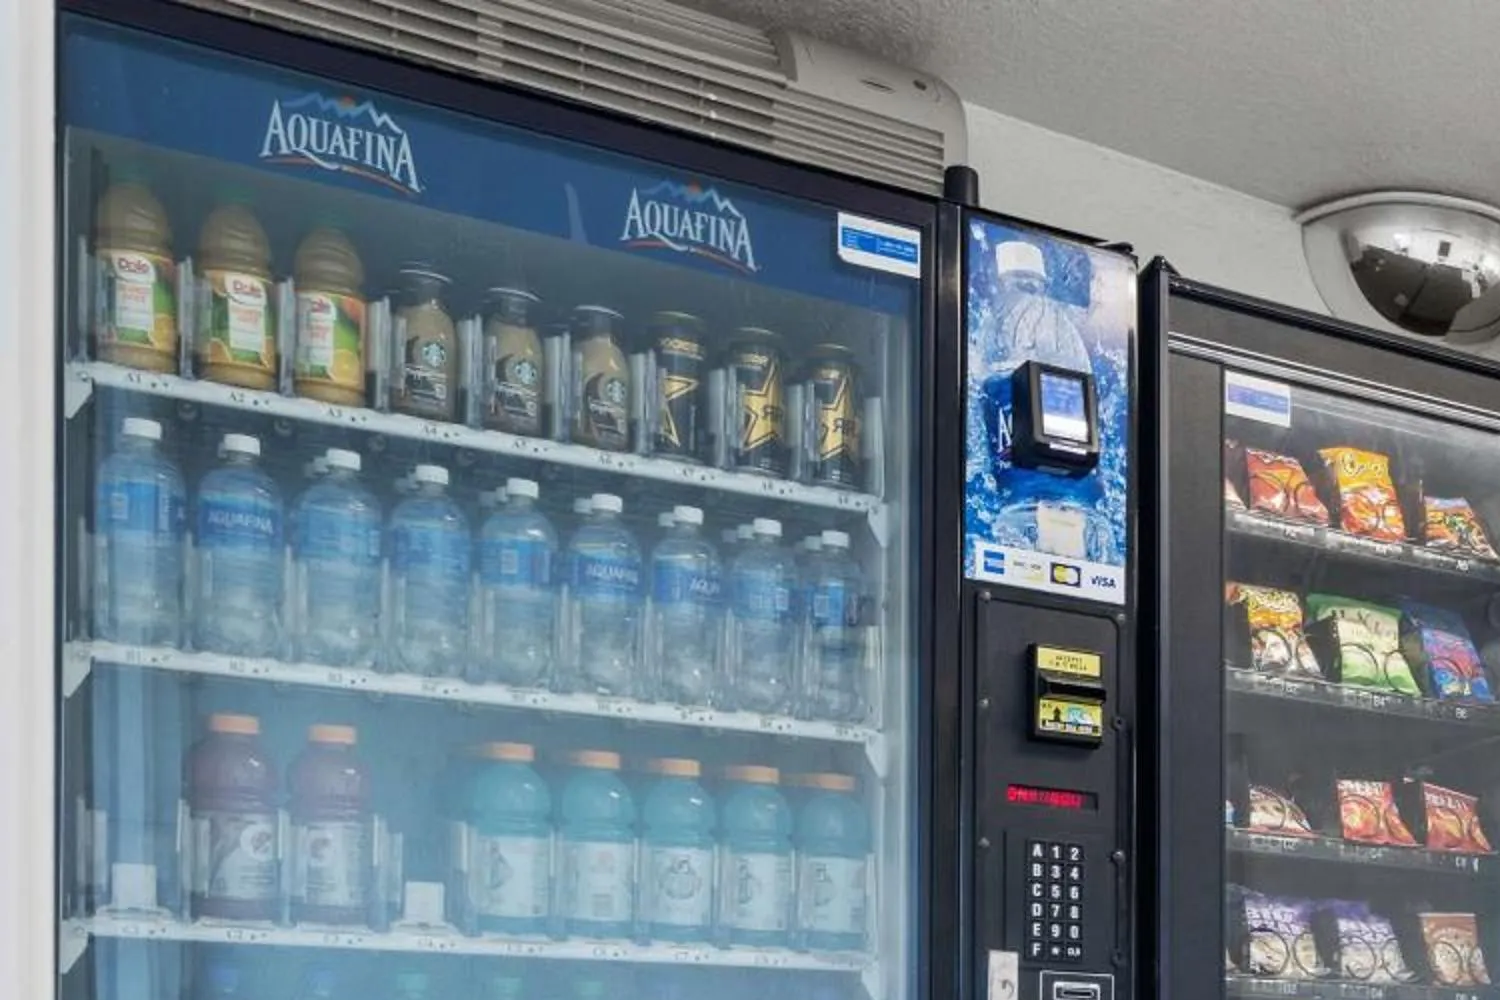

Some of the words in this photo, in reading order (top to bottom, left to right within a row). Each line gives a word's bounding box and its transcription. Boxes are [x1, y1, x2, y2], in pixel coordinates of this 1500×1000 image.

[261, 98, 419, 193] AQUAFINA
[620, 186, 756, 273] AQUAFINA
[1091, 575, 1117, 588] VISA
[1032, 843, 1043, 857] A
[1052, 845, 1060, 859] 1
[1070, 847, 1079, 861] 2
[1032, 863, 1042, 877] B
[1051, 865, 1061, 878] 3
[1070, 866, 1079, 880] 4
[1032, 883, 1042, 897] C
[1051, 885, 1061, 898] 5
[1070, 886, 1079, 899] 6
[1032, 903, 1042, 916] D
[1051, 904, 1060, 917] 7
[1070, 905, 1079, 919] 8
[1033, 923, 1042, 936] E
[1051, 924, 1061, 937] 9
[1070, 925, 1079, 939] 0
[1033, 943, 1042, 956] F
